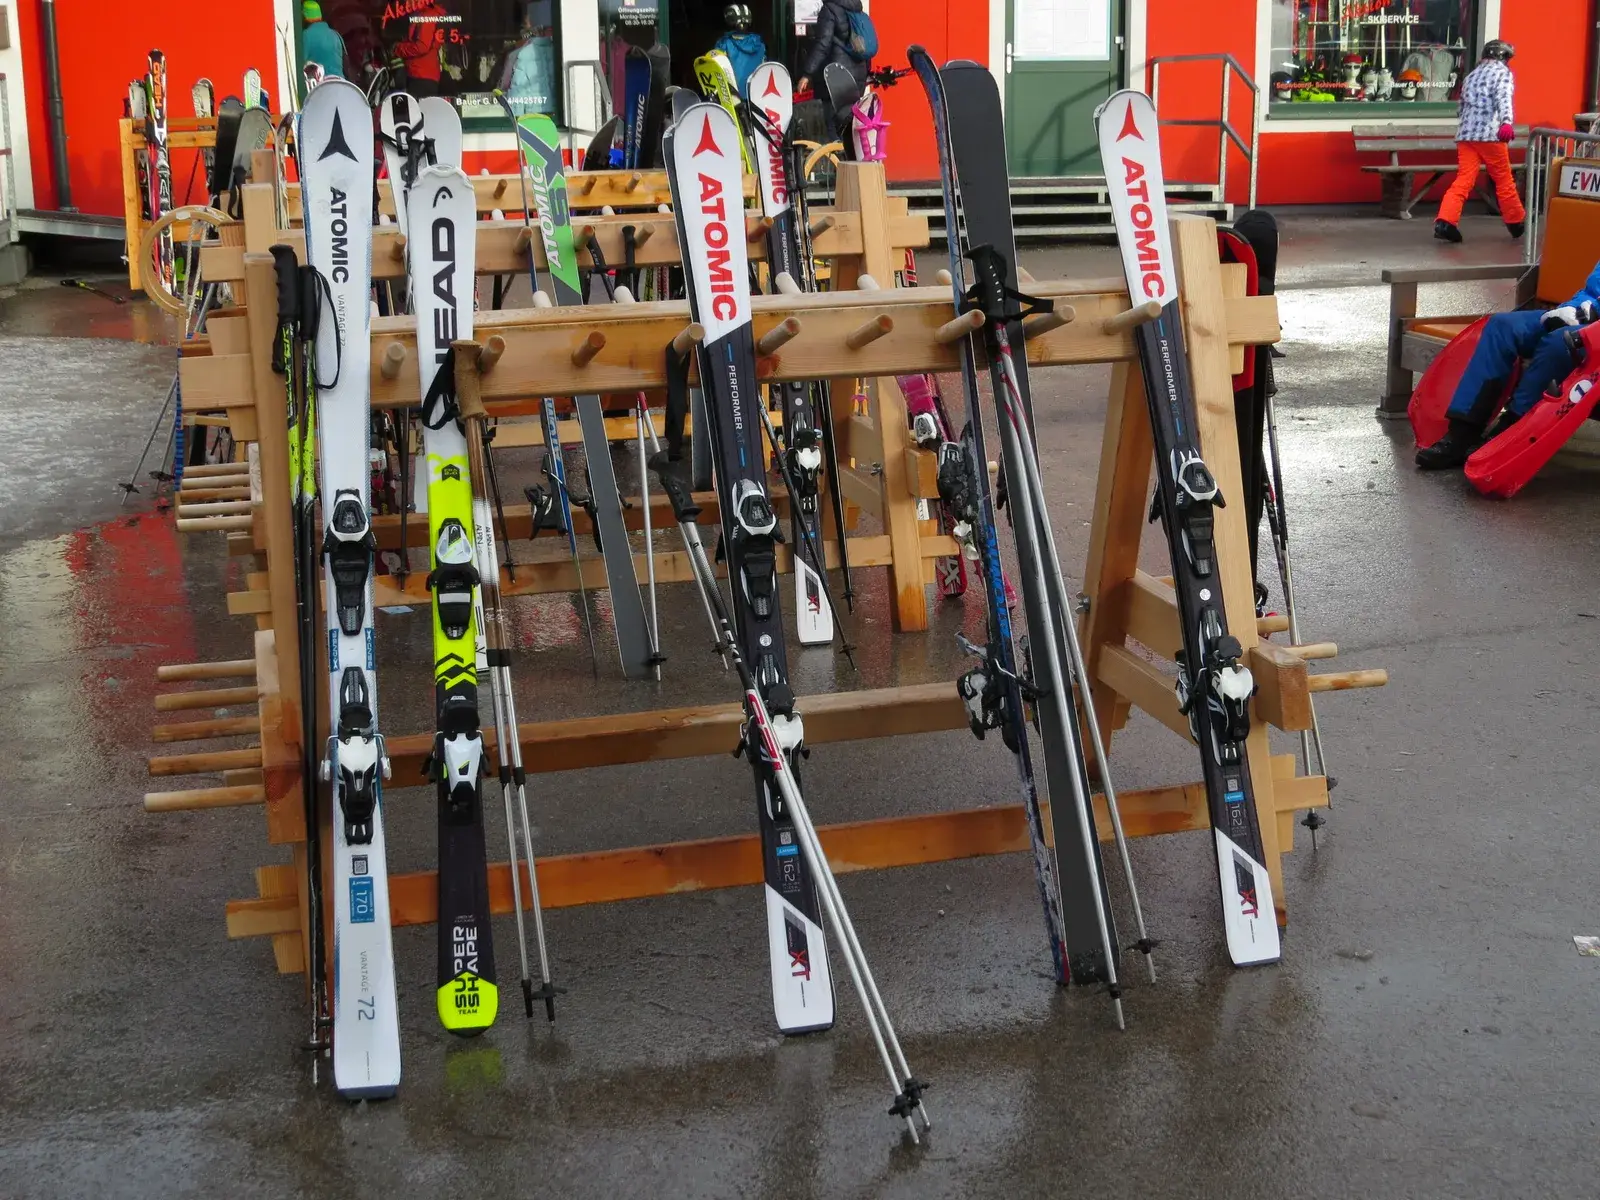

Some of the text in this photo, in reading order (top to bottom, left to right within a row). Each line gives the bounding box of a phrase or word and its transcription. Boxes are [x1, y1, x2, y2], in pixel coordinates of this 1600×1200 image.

[435, 28, 445, 43] €
[456, 97, 481, 106] Bauer
[493, 96, 548, 105] 04/4425767
[634, 93, 646, 149] ATOMIC
[1570, 171, 1600, 192] EVN
[330, 185, 349, 284] ATOMIC
[528, 164, 562, 269] ATOMIC
[1121, 156, 1166, 298] ATOMIC
[697, 172, 738, 321] ATOMIC
[337, 294, 346, 334] VANTAGE
[1160, 339, 1177, 401] PERFORMER
[728, 365, 743, 430] PERFORMER
[1230, 803, 1243, 826] 162
[782, 858, 796, 882] 162
[356, 890, 368, 914] 170
[1239, 889, 1259, 918] XT
[359, 950, 369, 993] VANTAGE
[466, 926, 480, 1008] SHAPE
[788, 951, 811, 982] XT
[357, 995, 376, 1021] 72
